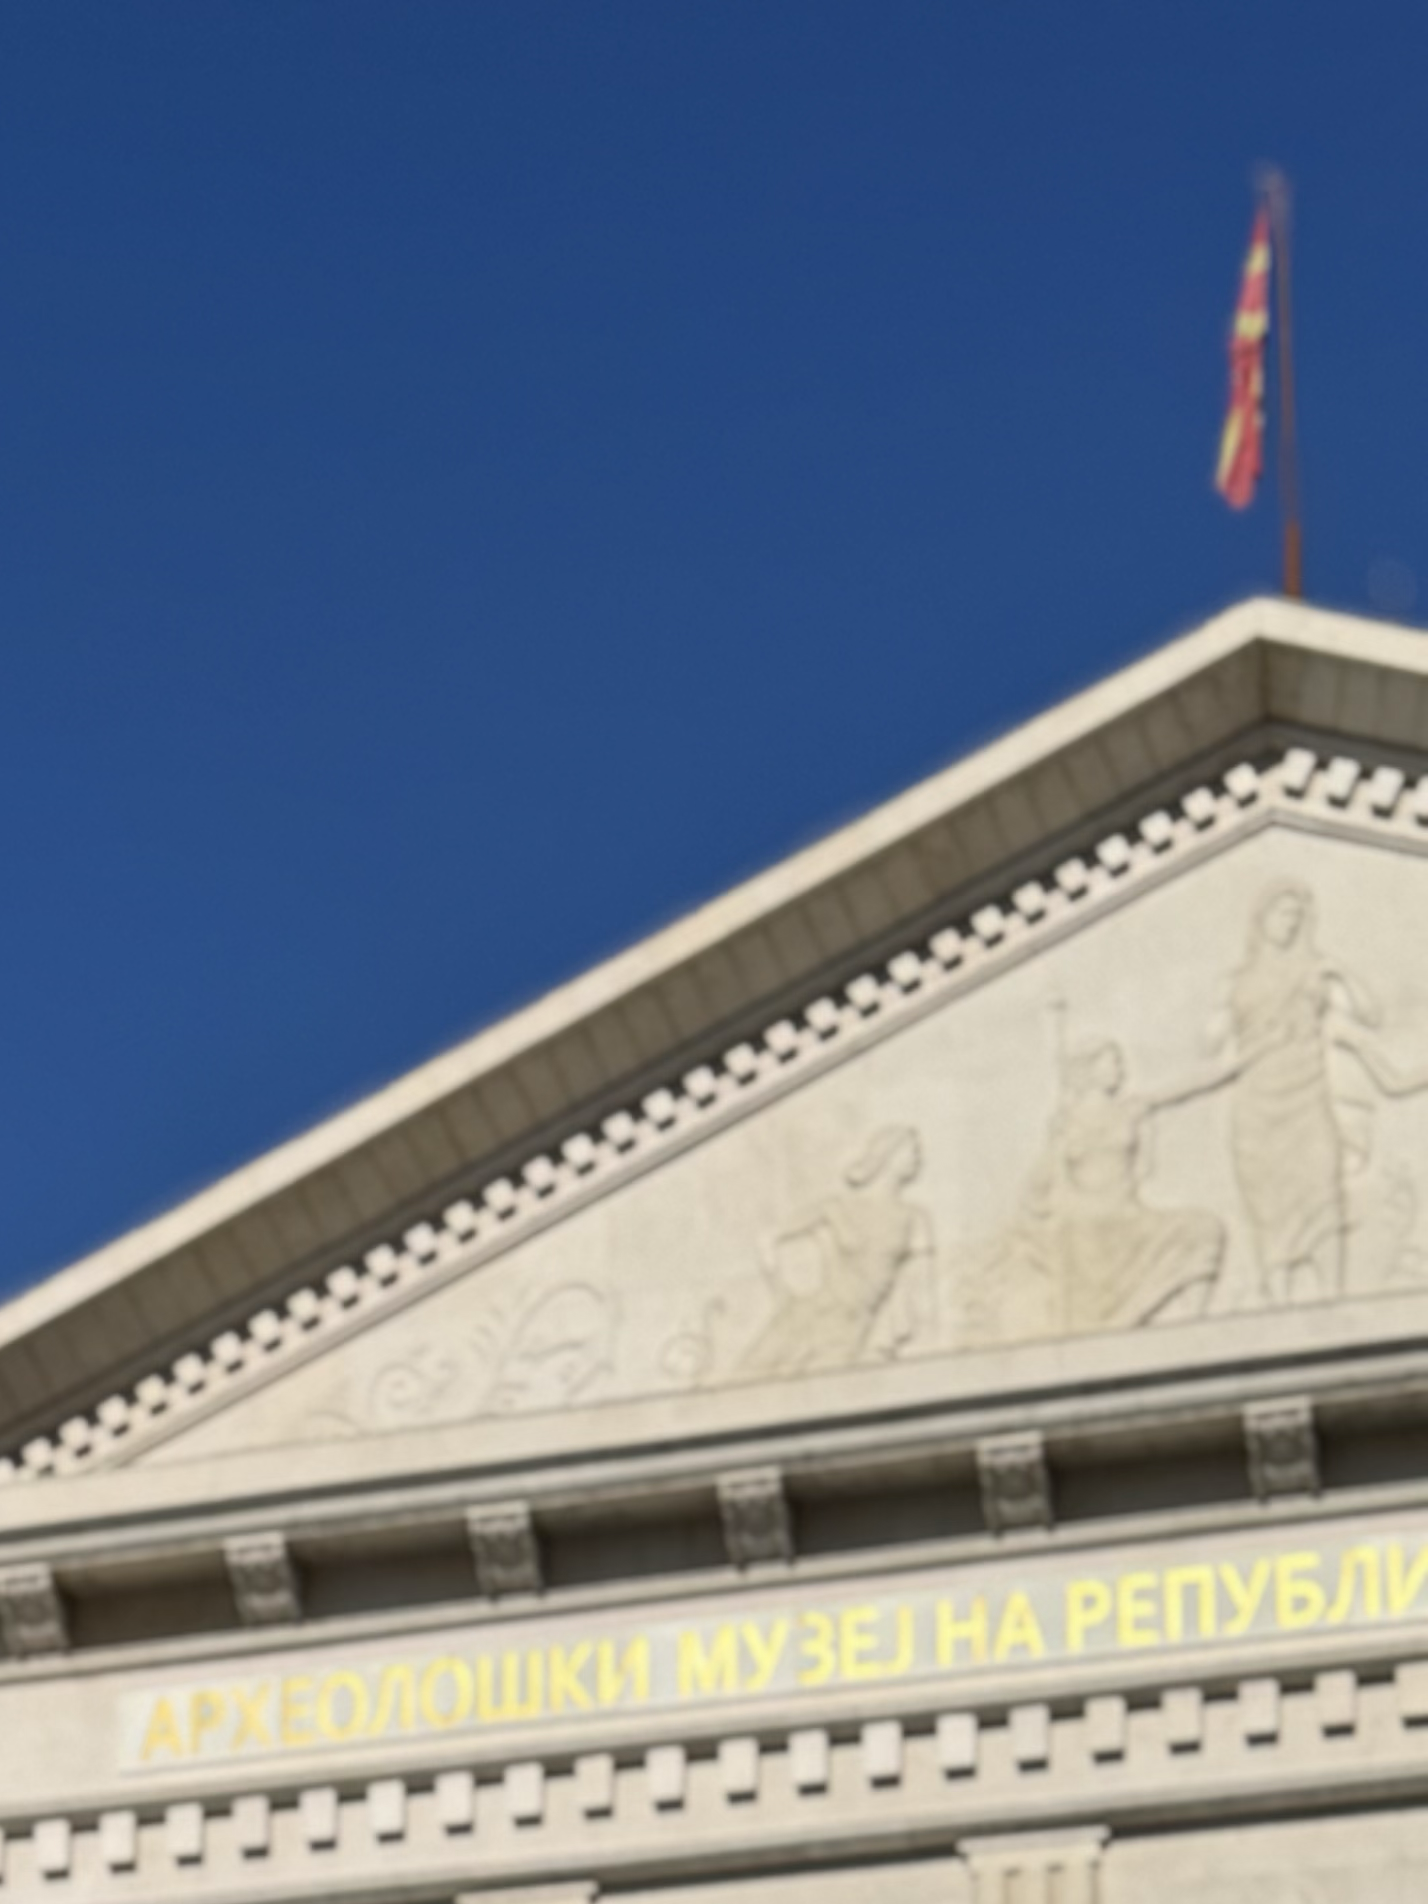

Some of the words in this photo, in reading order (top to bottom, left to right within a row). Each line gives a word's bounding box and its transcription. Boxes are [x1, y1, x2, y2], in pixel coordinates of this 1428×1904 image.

[141, 1636, 650, 1760] АРХЕОЛОШКИ
[677, 1606, 915, 1696] МУЗЕЈ
[936, 1590, 1046, 1666] НА
